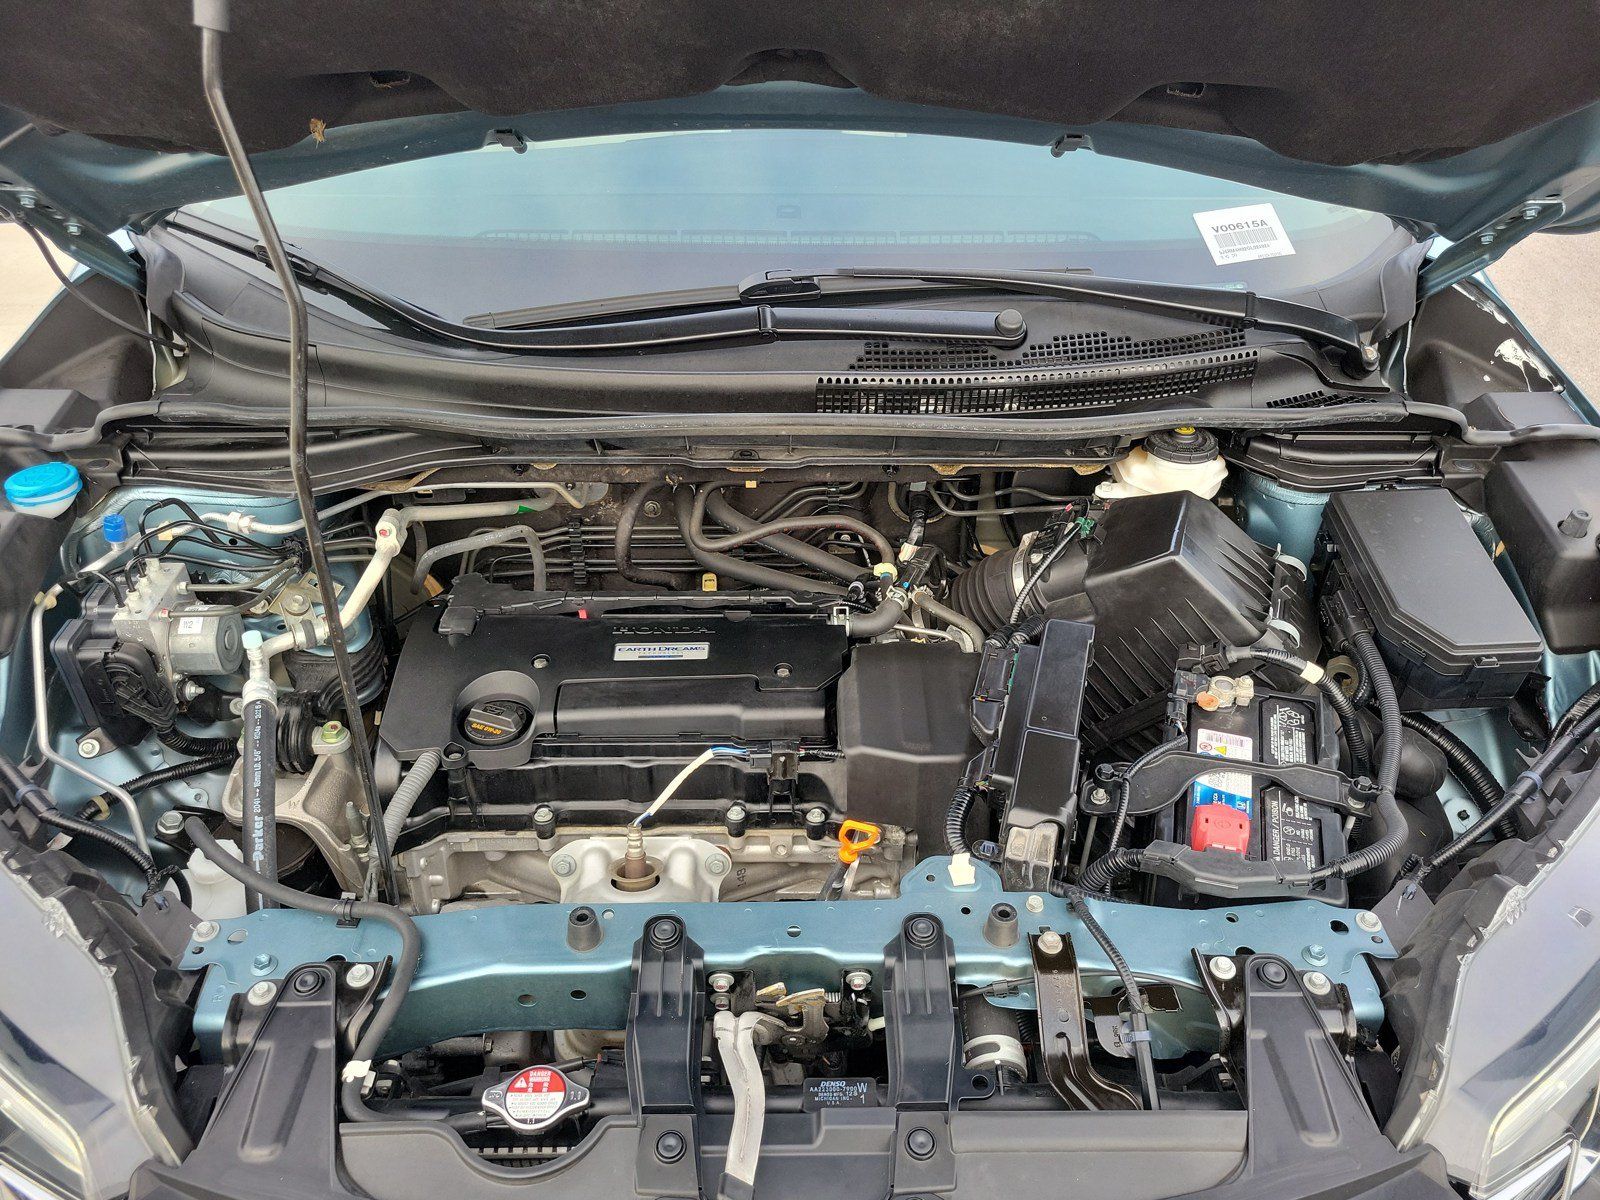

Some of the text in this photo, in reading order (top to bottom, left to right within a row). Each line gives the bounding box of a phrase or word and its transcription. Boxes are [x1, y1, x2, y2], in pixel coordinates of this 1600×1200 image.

[1211, 219, 1268, 233] V00615A
[612, 626, 716, 634] HONDA
[1271, 801, 1279, 824] POISON
[252, 815, 264, 862] Parker
[1271, 830, 1280, 856] DANGER
[857, 1082, 867, 1093] W
[860, 1094, 865, 1104] 1
